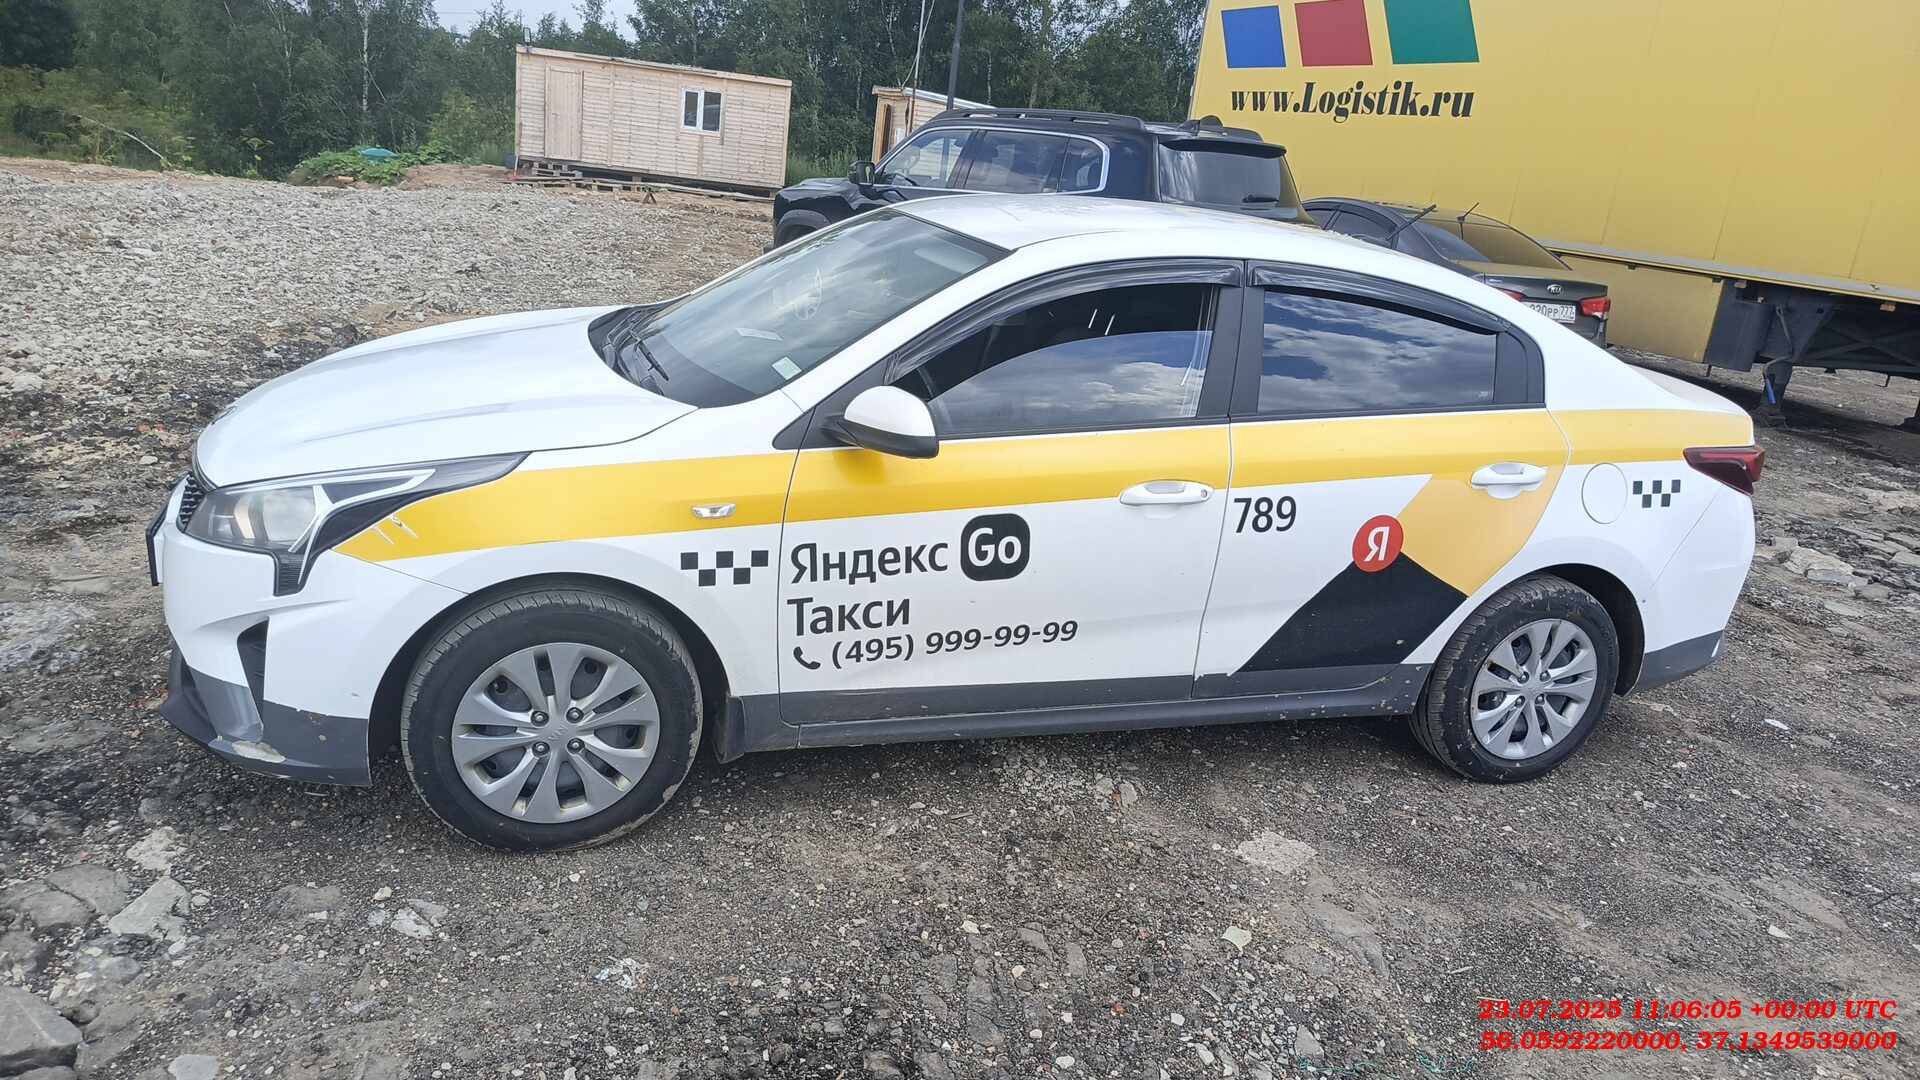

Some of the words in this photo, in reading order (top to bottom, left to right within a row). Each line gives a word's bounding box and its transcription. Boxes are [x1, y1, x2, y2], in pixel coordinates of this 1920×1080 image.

[1231, 80, 1474, 124] www.Logistik.ru
[1234, 495, 1297, 533] 789
[790, 543, 948, 585] Яндекс
[967, 527, 1022, 567] Go
[1363, 526, 1390, 562] Я
[786, 597, 911, 637] Такси
[831, 633, 915, 669] (495)
[925, 620, 1079, 655] 999-99-99
